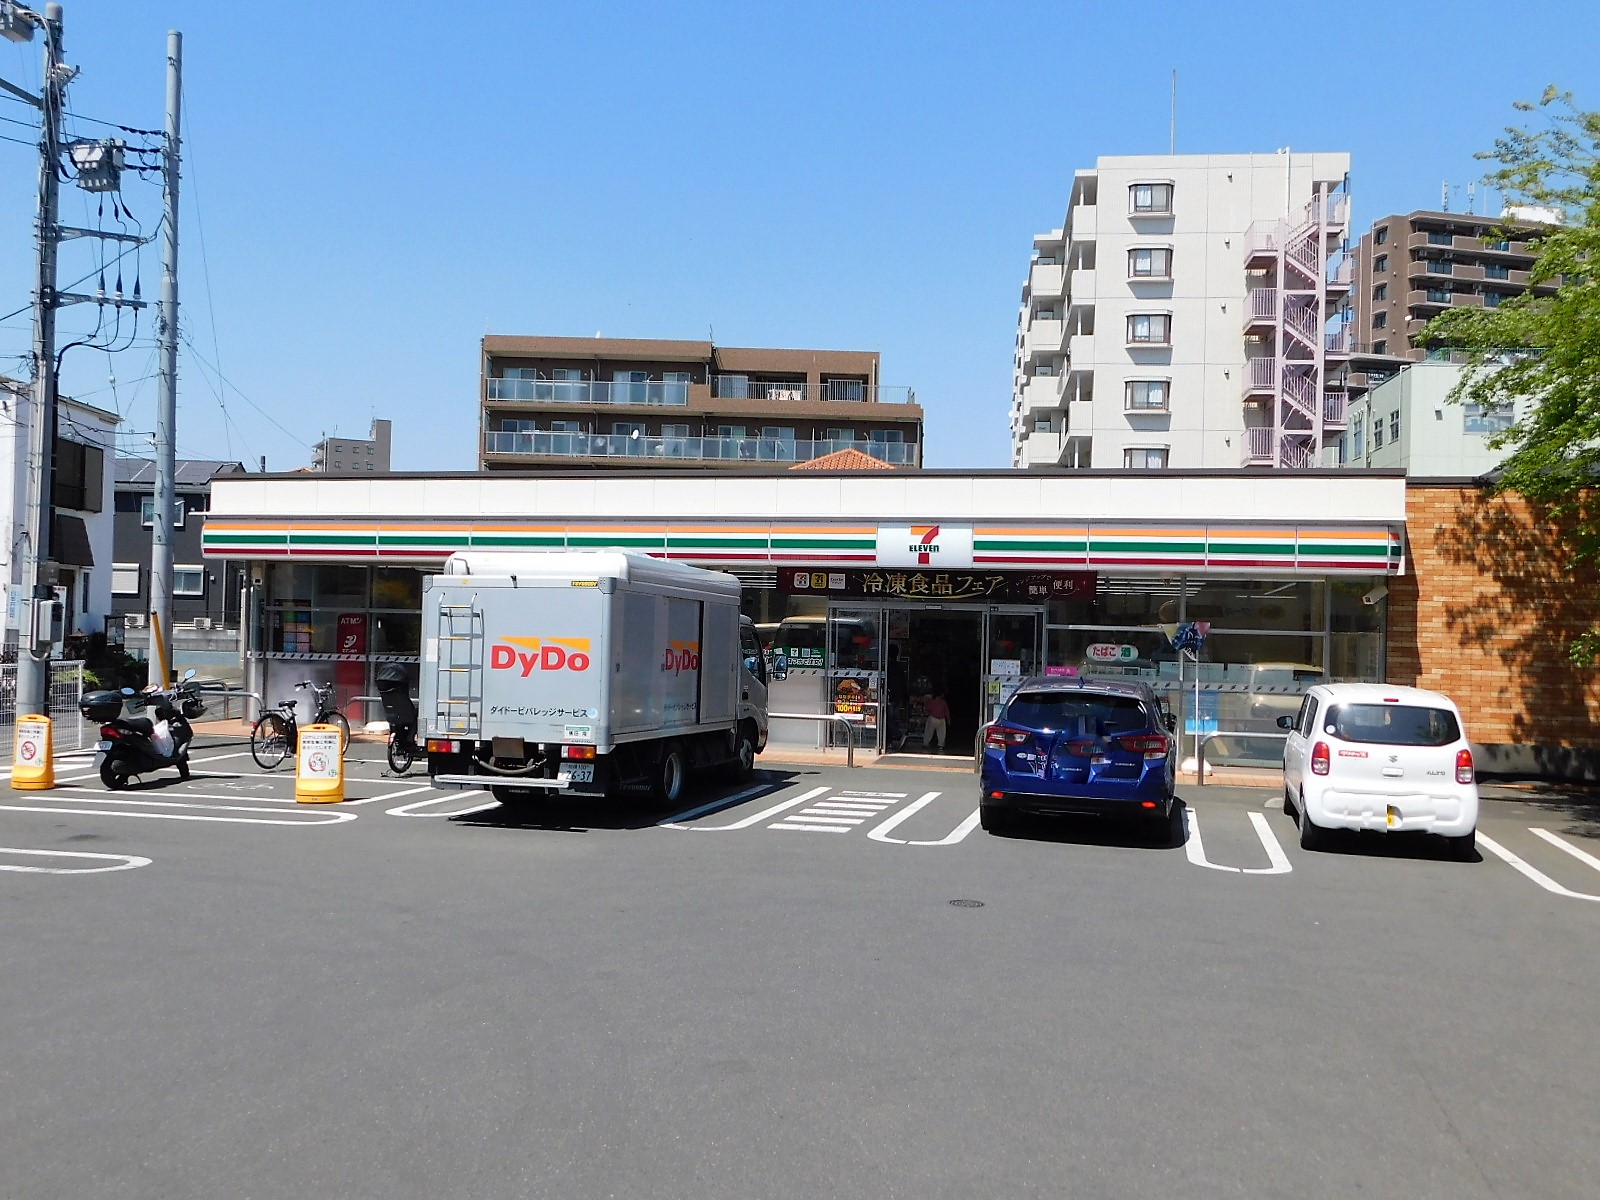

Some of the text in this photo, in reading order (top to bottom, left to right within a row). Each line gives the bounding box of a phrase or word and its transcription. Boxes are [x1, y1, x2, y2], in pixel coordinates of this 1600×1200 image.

[863, 572, 1004, 595] 冷凍食品フェア
[1028, 585, 1048, 595] 簡単
[1053, 579, 1074, 590] 便利
[1092, 646, 1116, 657] たばこ
[491, 645, 590, 677] DyDo
[665, 648, 699, 677] DyDo
[490, 705, 588, 718] ダイドービバレッジサービス
